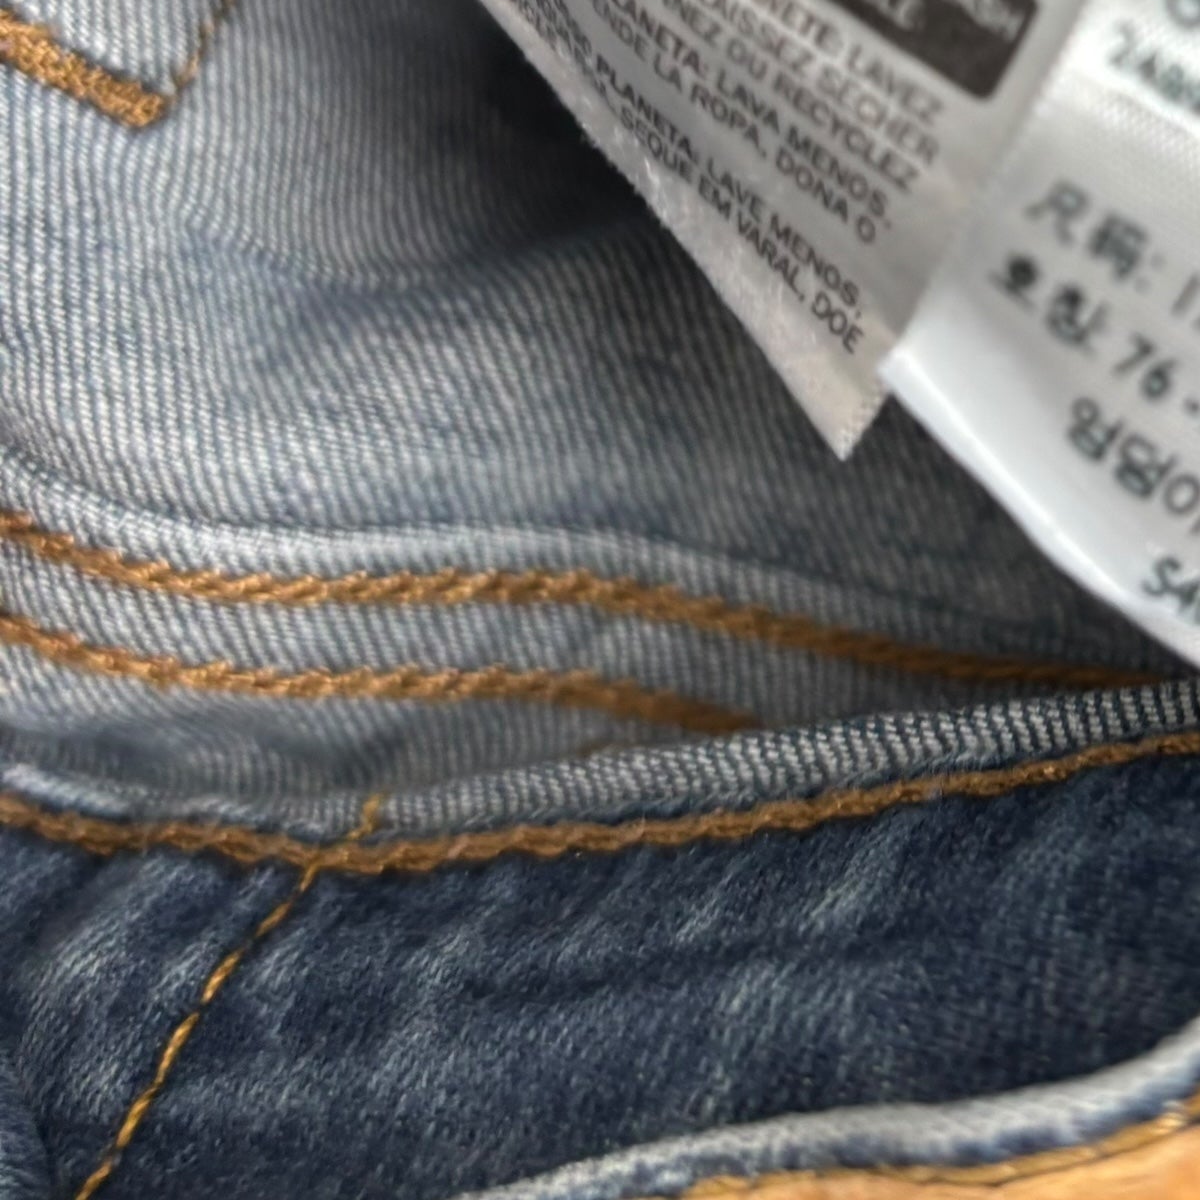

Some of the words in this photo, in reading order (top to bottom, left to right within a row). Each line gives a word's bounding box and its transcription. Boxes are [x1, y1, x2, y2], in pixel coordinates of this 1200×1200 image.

[726, 38, 769, 81] OU
[716, 66, 781, 135] LAVA
[653, 51, 684, 94] LA
[775, 146, 849, 225] DONA
[855, 214, 877, 245] O
[706, 156, 763, 225] LAVE
[619, 104, 695, 185] SEQUE
[697, 173, 733, 222] EM
[810, 290, 866, 355] DOE
[1112, 331, 1179, 402] 76
